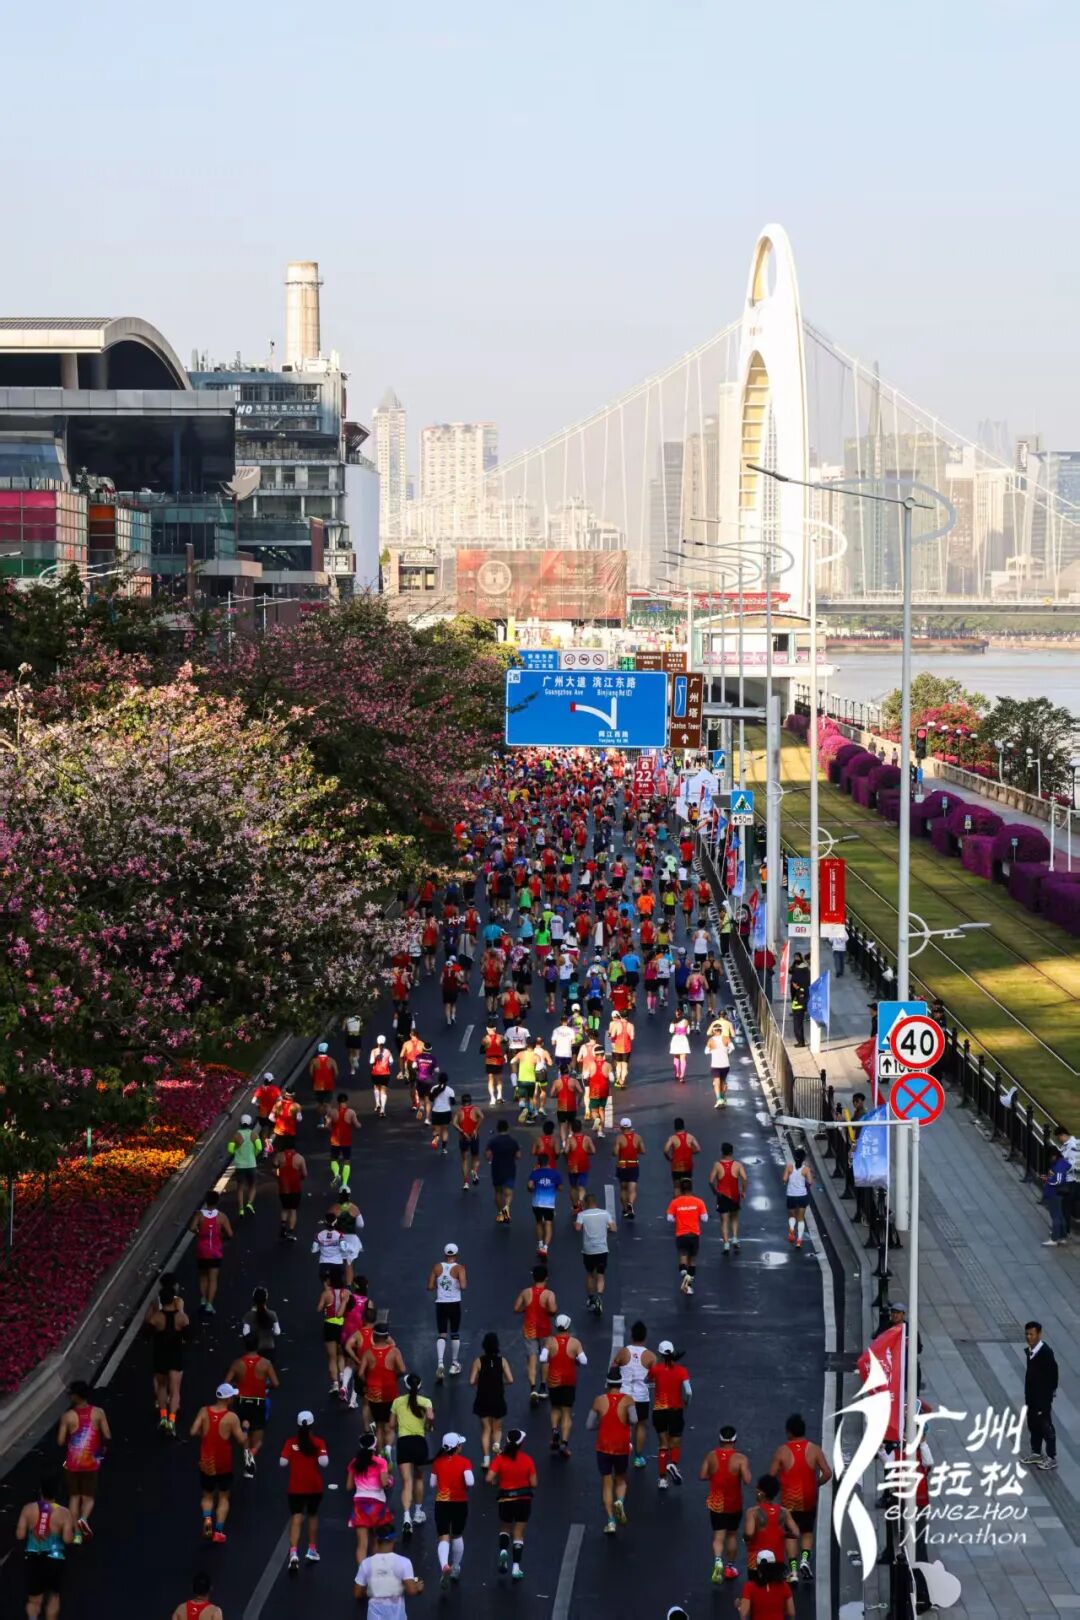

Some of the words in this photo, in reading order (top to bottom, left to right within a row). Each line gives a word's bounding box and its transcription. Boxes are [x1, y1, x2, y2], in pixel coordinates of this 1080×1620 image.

[542, 676, 586, 688] 广州大道
[592, 676, 636, 688] 滨江东路
[689, 677, 700, 718] 广州塔
[635, 770, 653, 782] 22
[738, 815, 752, 824] 50m
[901, 1029, 935, 1056] 40
